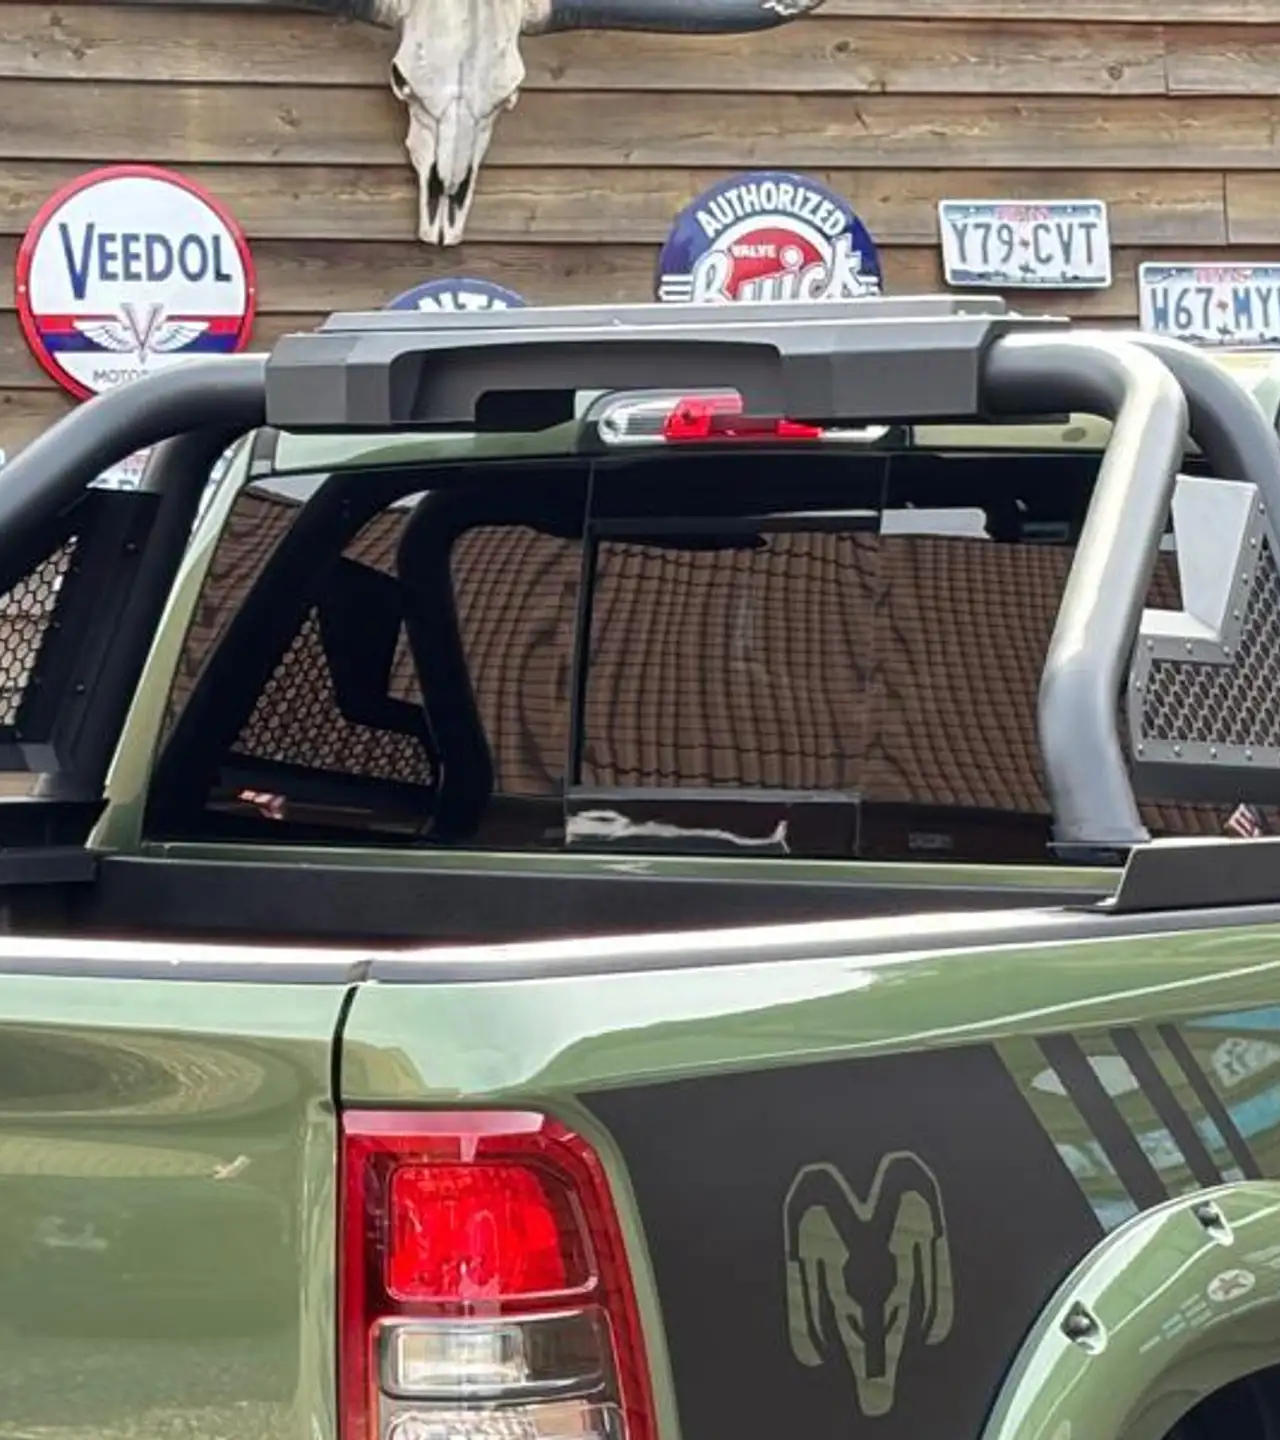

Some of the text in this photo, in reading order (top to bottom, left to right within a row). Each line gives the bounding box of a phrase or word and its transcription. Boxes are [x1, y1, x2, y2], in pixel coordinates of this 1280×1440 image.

[696, 181, 846, 238] AUTHORIZED
[59, 222, 232, 301] VEEDOL
[950, 222, 1014, 264] Y79
[1150, 286, 1215, 330] W67
